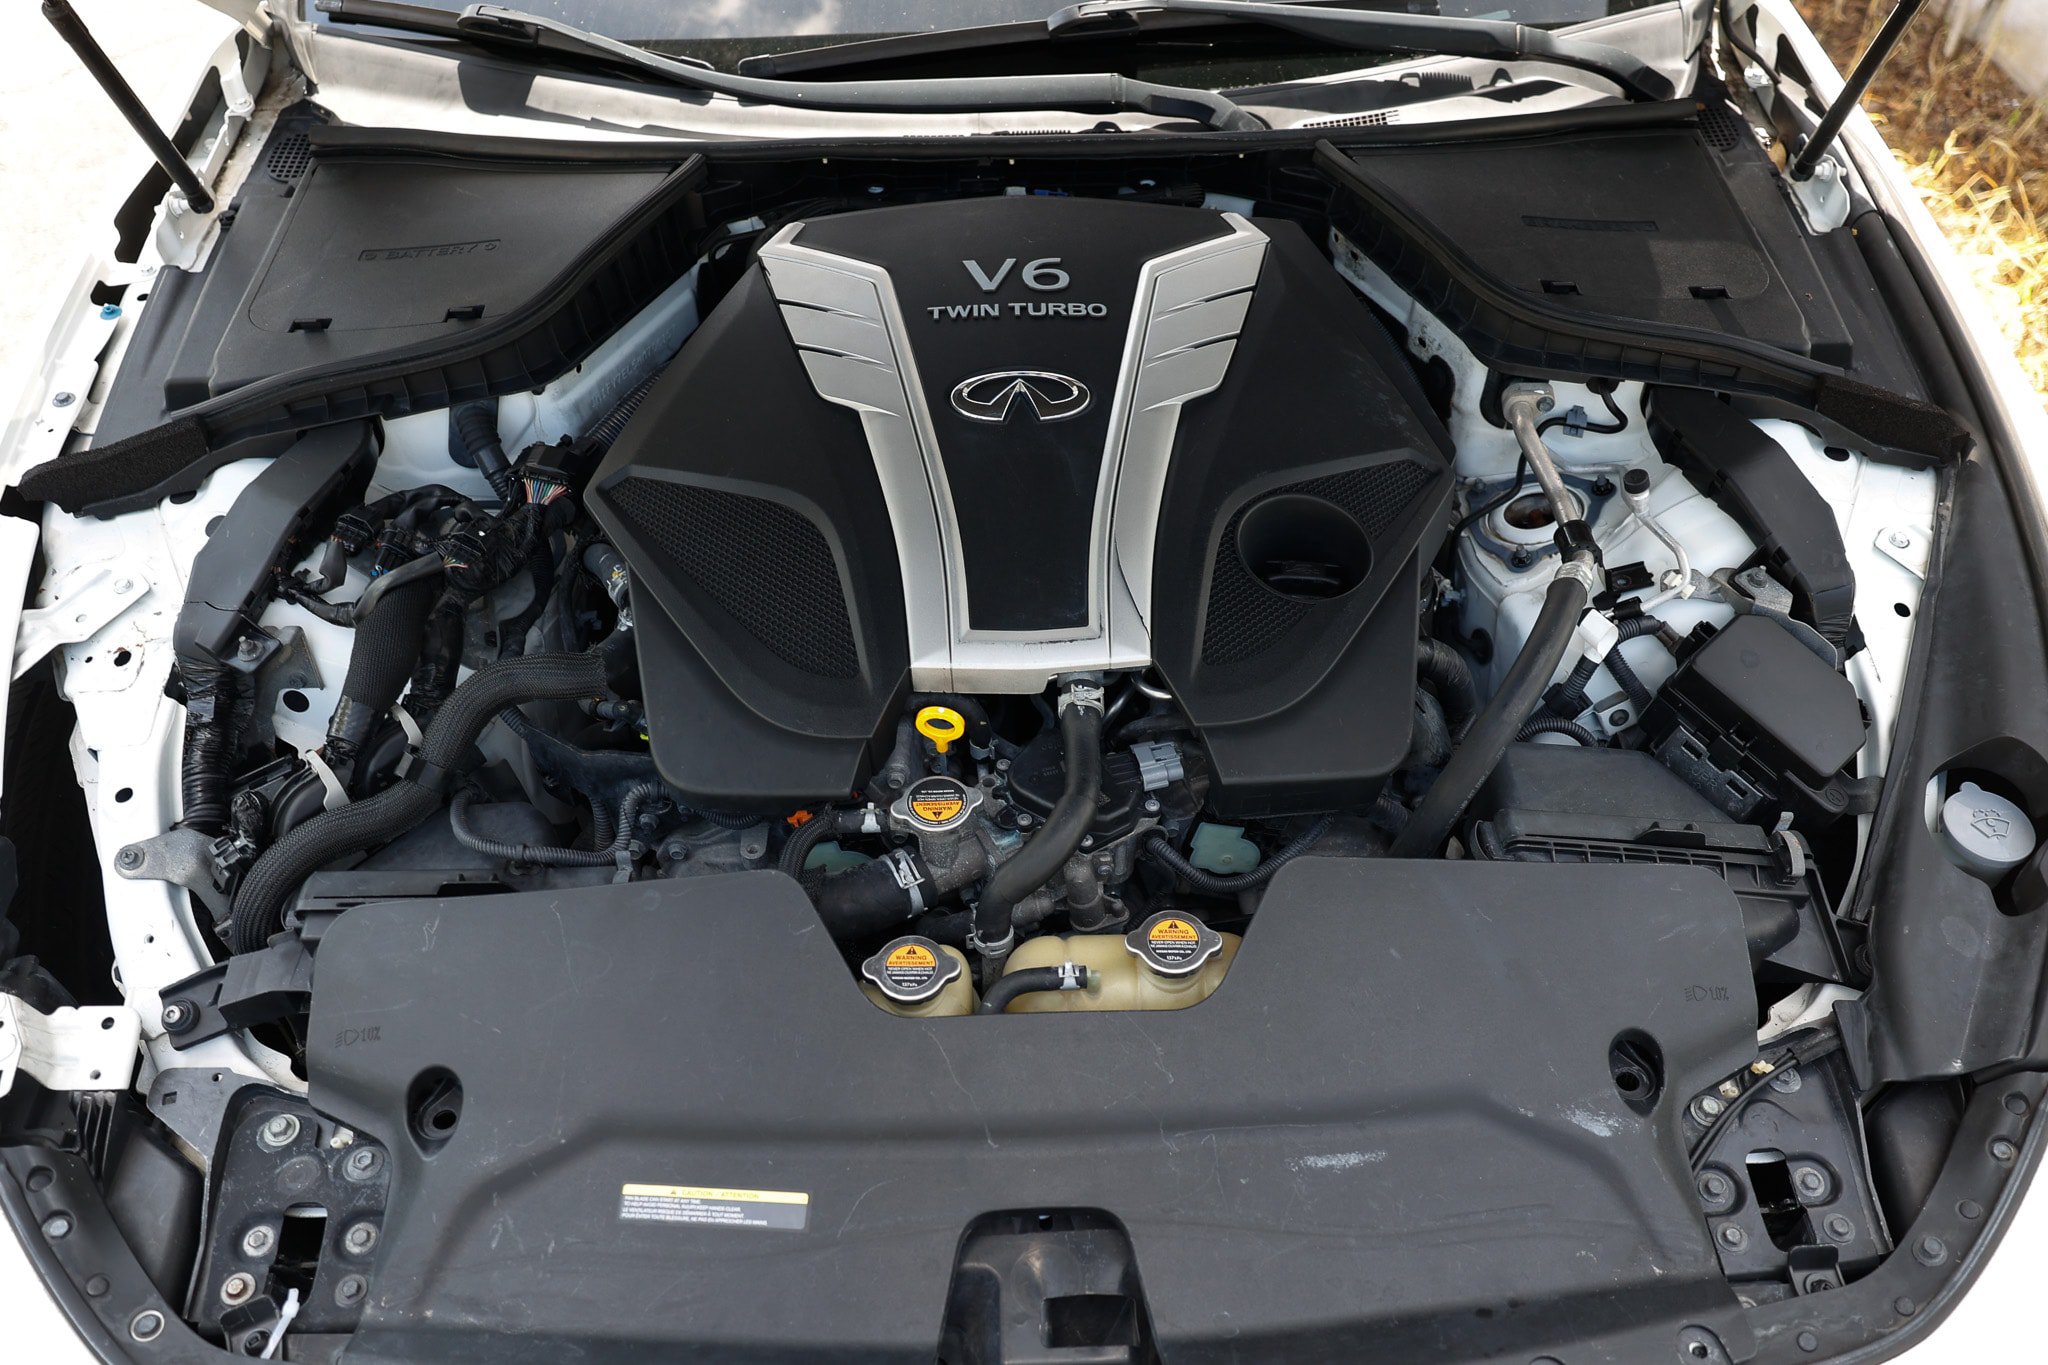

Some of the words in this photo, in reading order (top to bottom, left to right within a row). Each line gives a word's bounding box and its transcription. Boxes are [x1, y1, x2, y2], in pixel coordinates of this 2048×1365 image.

[962, 258, 1070, 292] V6
[927, 303, 1000, 320] TWIN
[1008, 302, 1108, 317] TURBO
